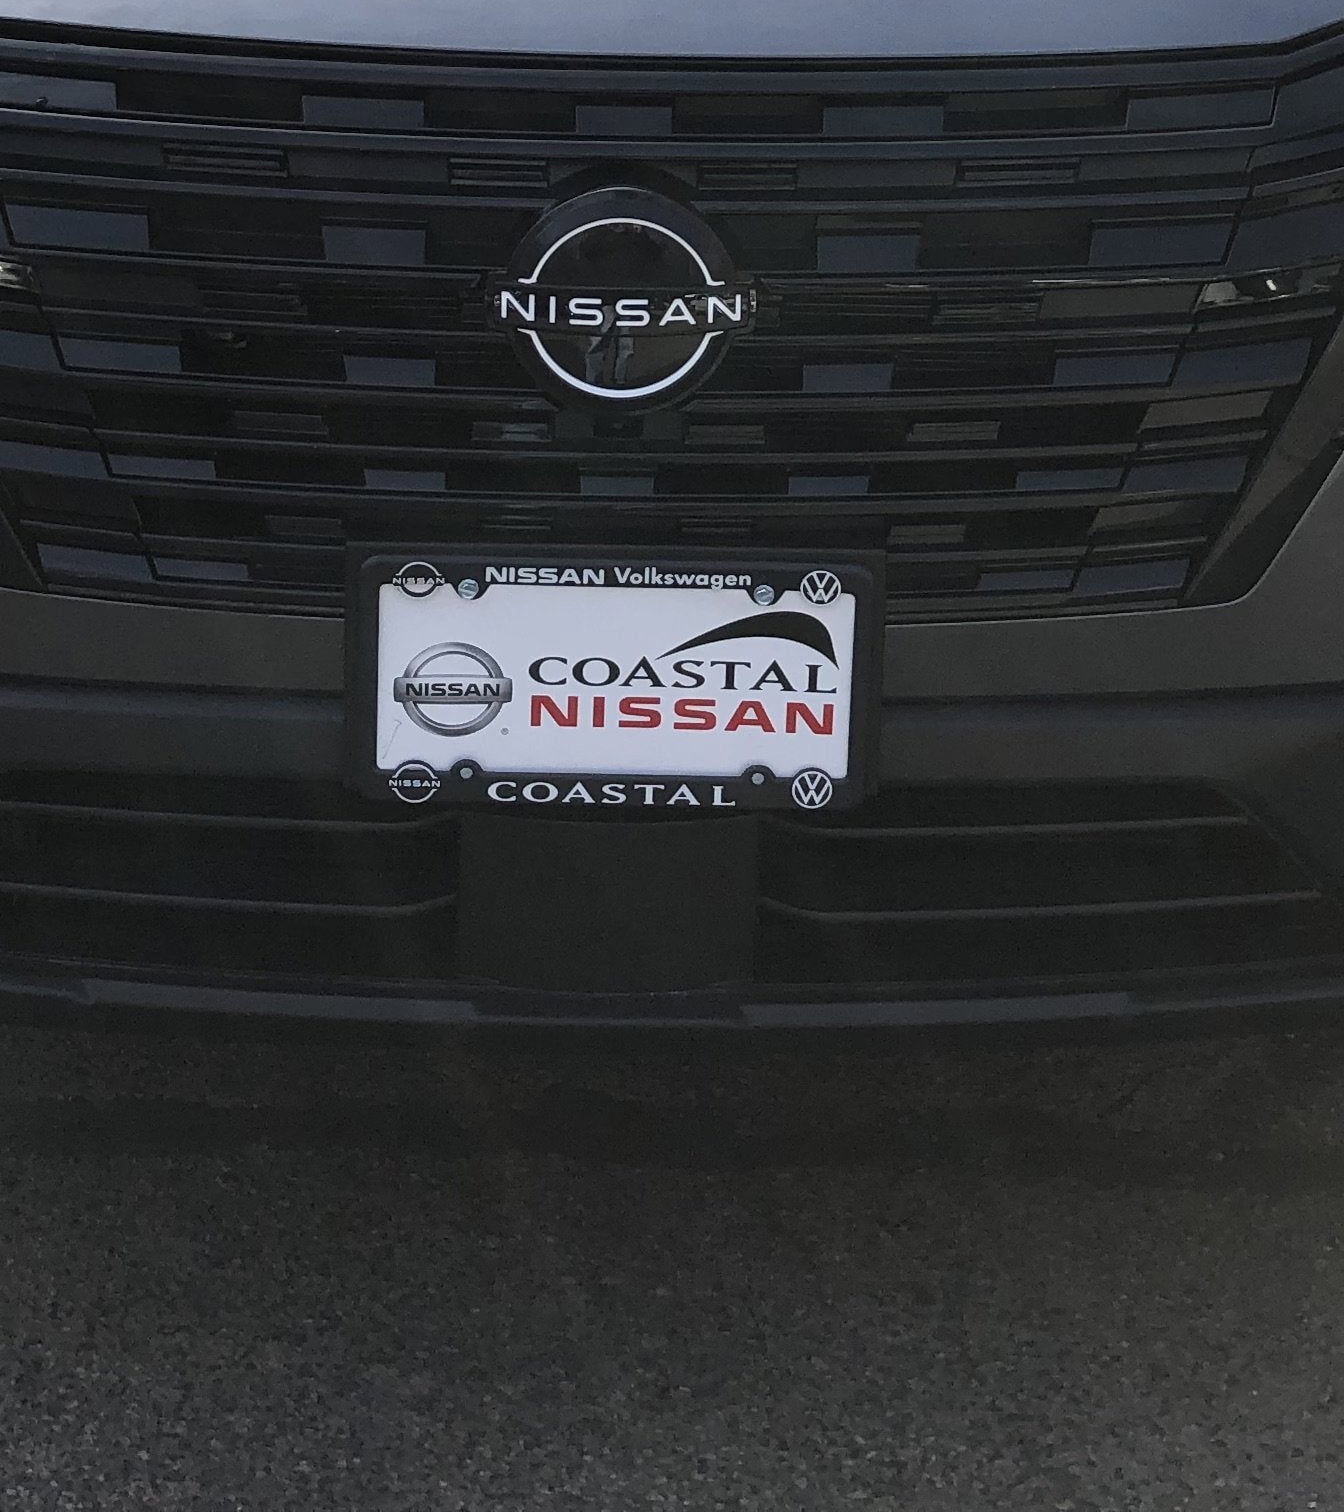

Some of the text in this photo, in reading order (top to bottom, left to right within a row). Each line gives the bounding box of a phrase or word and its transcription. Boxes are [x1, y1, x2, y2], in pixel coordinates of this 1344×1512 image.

[500, 291, 742, 327] NISSAN
[485, 566, 752, 589] NISSAN Volkswagen
[528, 656, 838, 694] COASTAL
[405, 683, 500, 697] NISSAN
[529, 695, 834, 735] NISSAN
[388, 779, 441, 788] NISSAN
[487, 781, 736, 807] COASTAL
